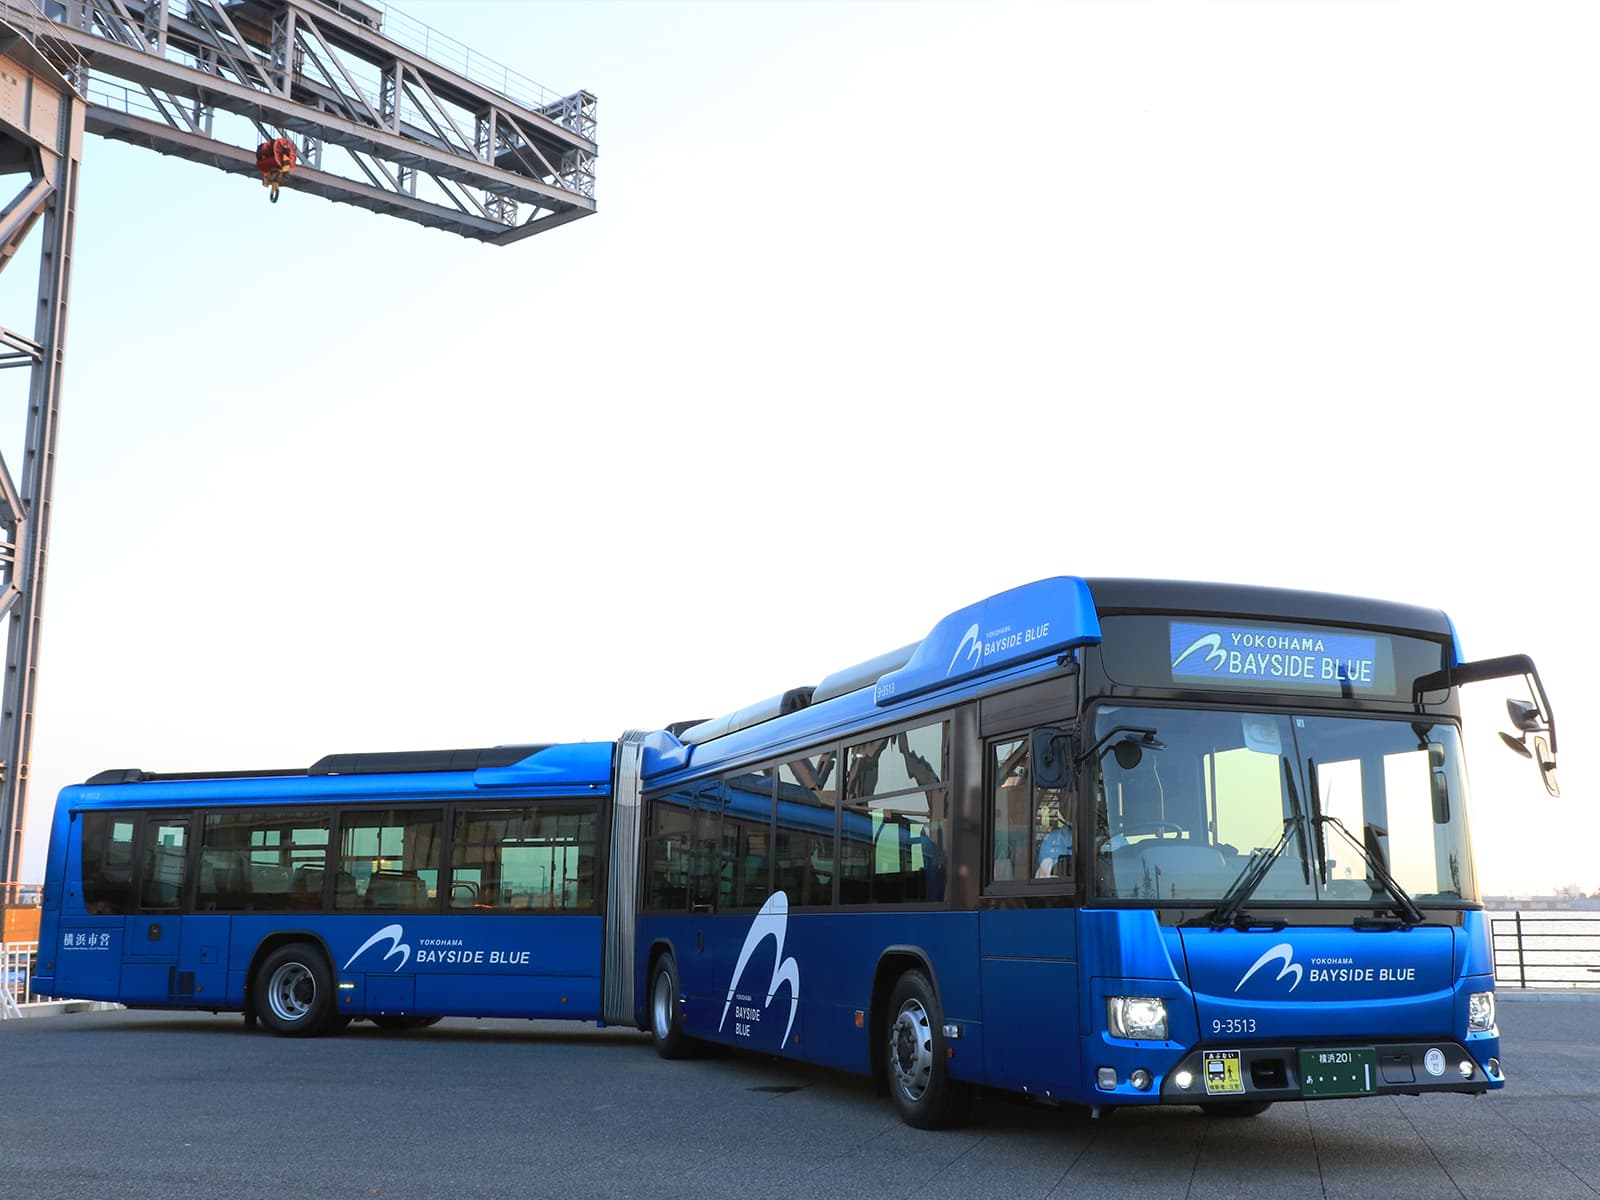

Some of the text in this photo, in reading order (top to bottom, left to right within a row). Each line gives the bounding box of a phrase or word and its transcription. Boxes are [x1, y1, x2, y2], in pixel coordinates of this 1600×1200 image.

[984, 623, 1049, 656] BAYSIDE BLUE
[1231, 633, 1325, 652] YOKOHAMA
[1229, 651, 1373, 682] BAYSIDE BLUE
[416, 950, 531, 964] BAYSIDE BLUE
[1311, 957, 1353, 965] YOKOHAMA
[1309, 968, 1416, 982] BAYSIDE BLUE
[735, 1006, 760, 1021] BAYSIDE
[735, 1023, 750, 1037] BLUE
[1212, 1018, 1256, 1034] 9-3513
